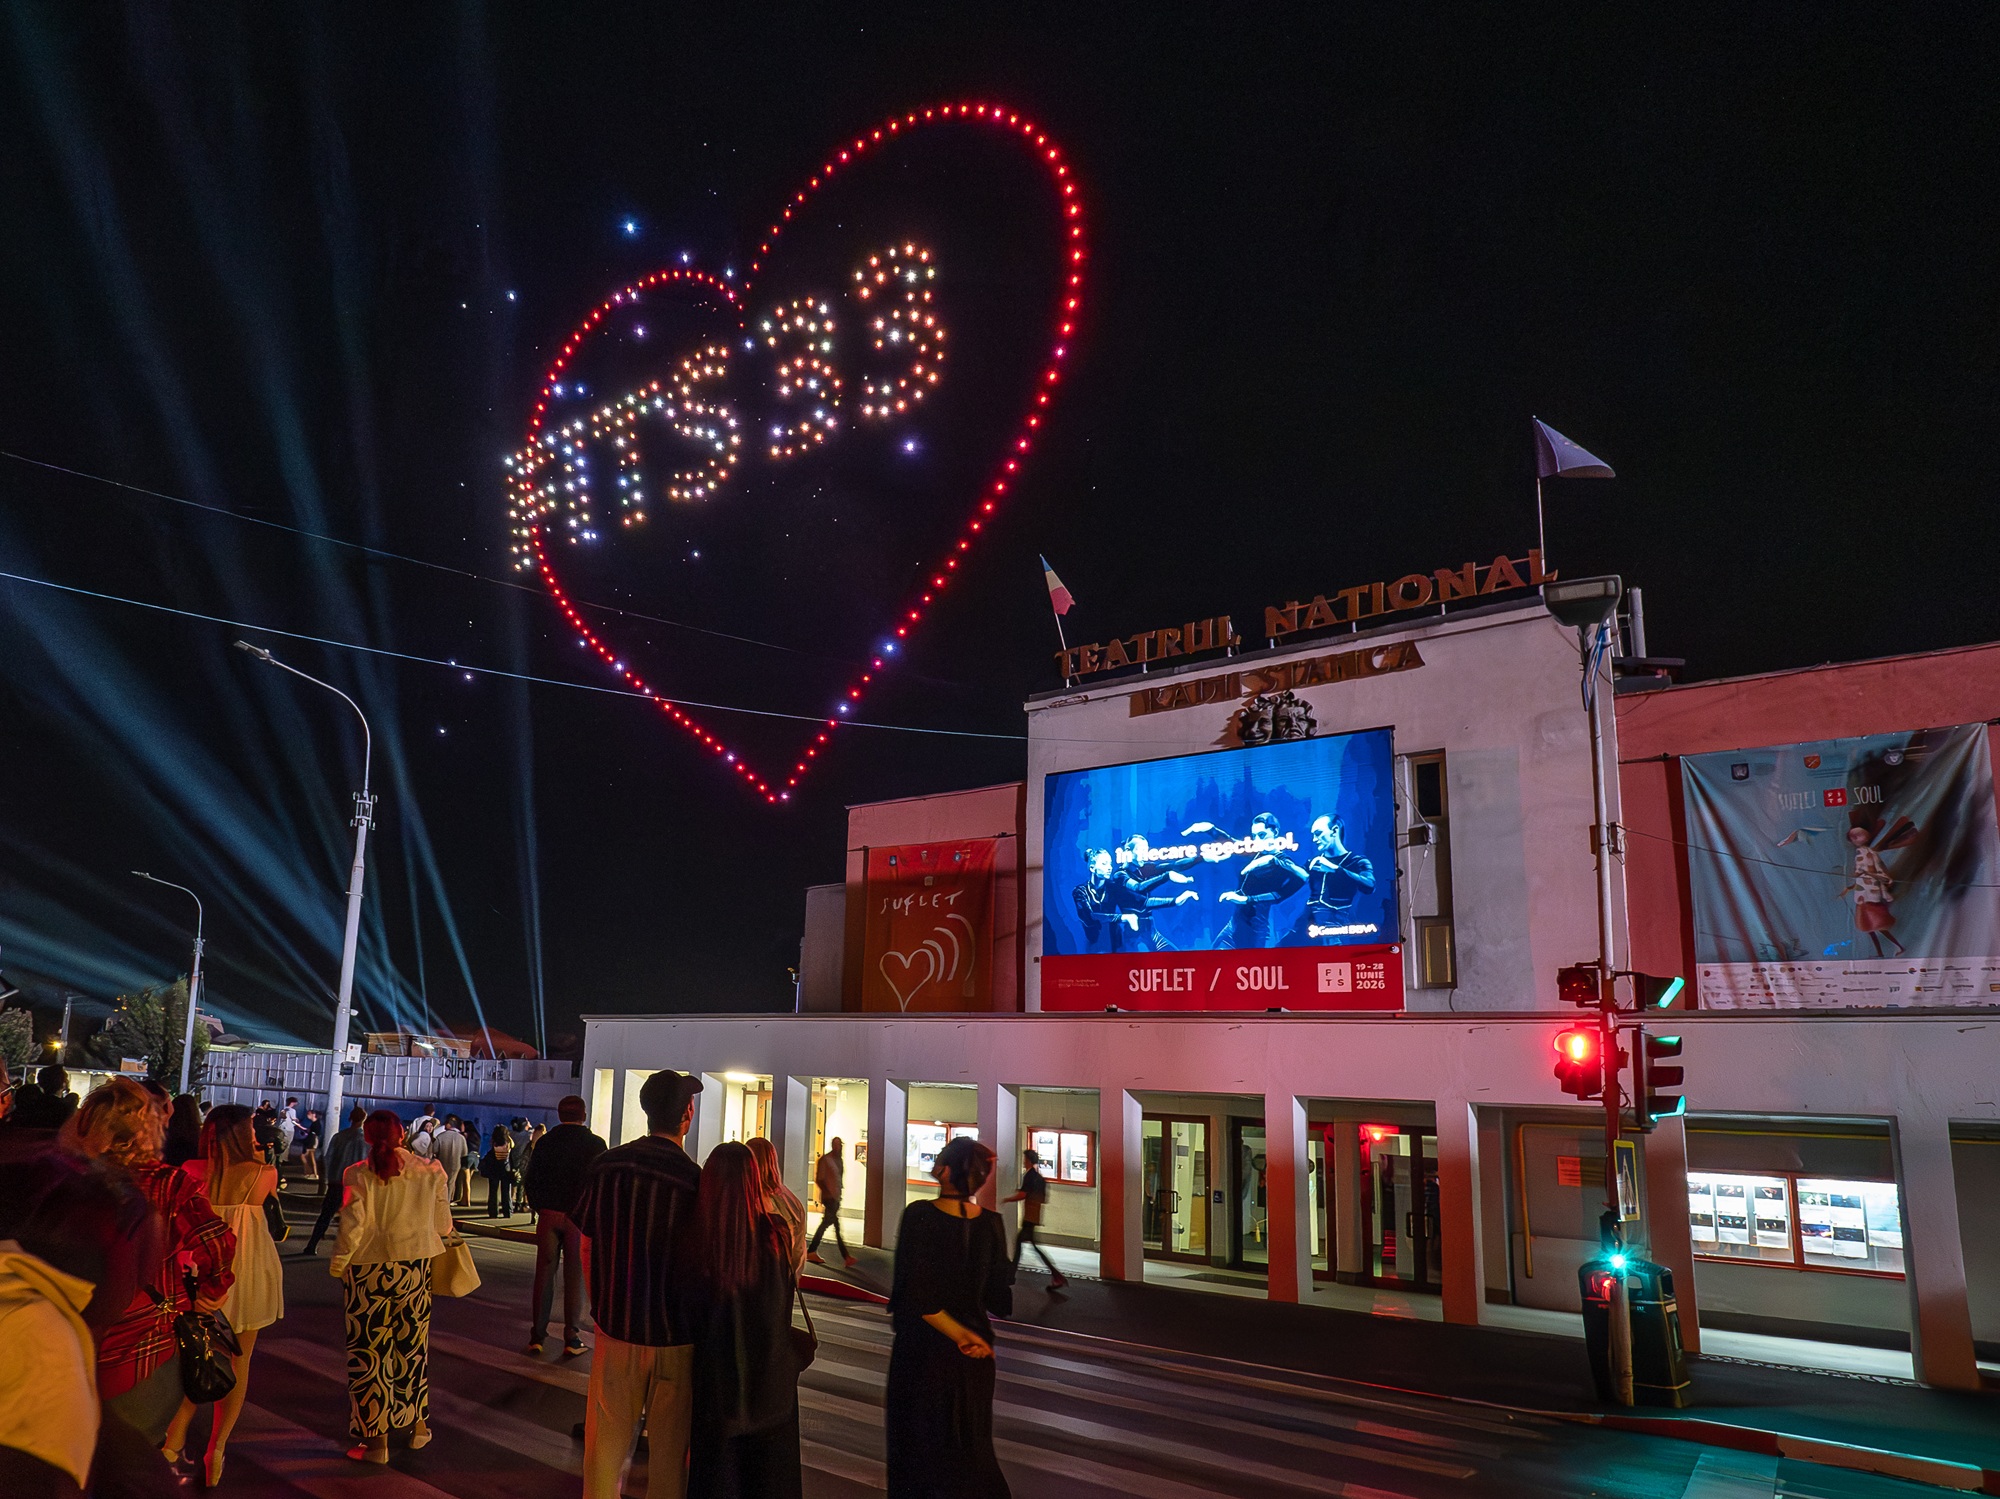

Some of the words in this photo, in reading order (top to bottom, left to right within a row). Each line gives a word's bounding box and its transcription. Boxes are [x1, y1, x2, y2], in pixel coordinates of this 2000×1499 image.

[1054, 615, 1242, 680] TEATRUL
[1265, 549, 1559, 638] NATIONAL
[1853, 785, 1883, 805] SOUL
[880, 890, 964, 916] SUFLET
[1128, 968, 1195, 992] SUFLET
[1236, 965, 1290, 991] SOUL
[1356, 971, 1385, 979] IUNIE
[1356, 979, 1386, 990] 2026
[444, 1058, 477, 1080] SUFLET
